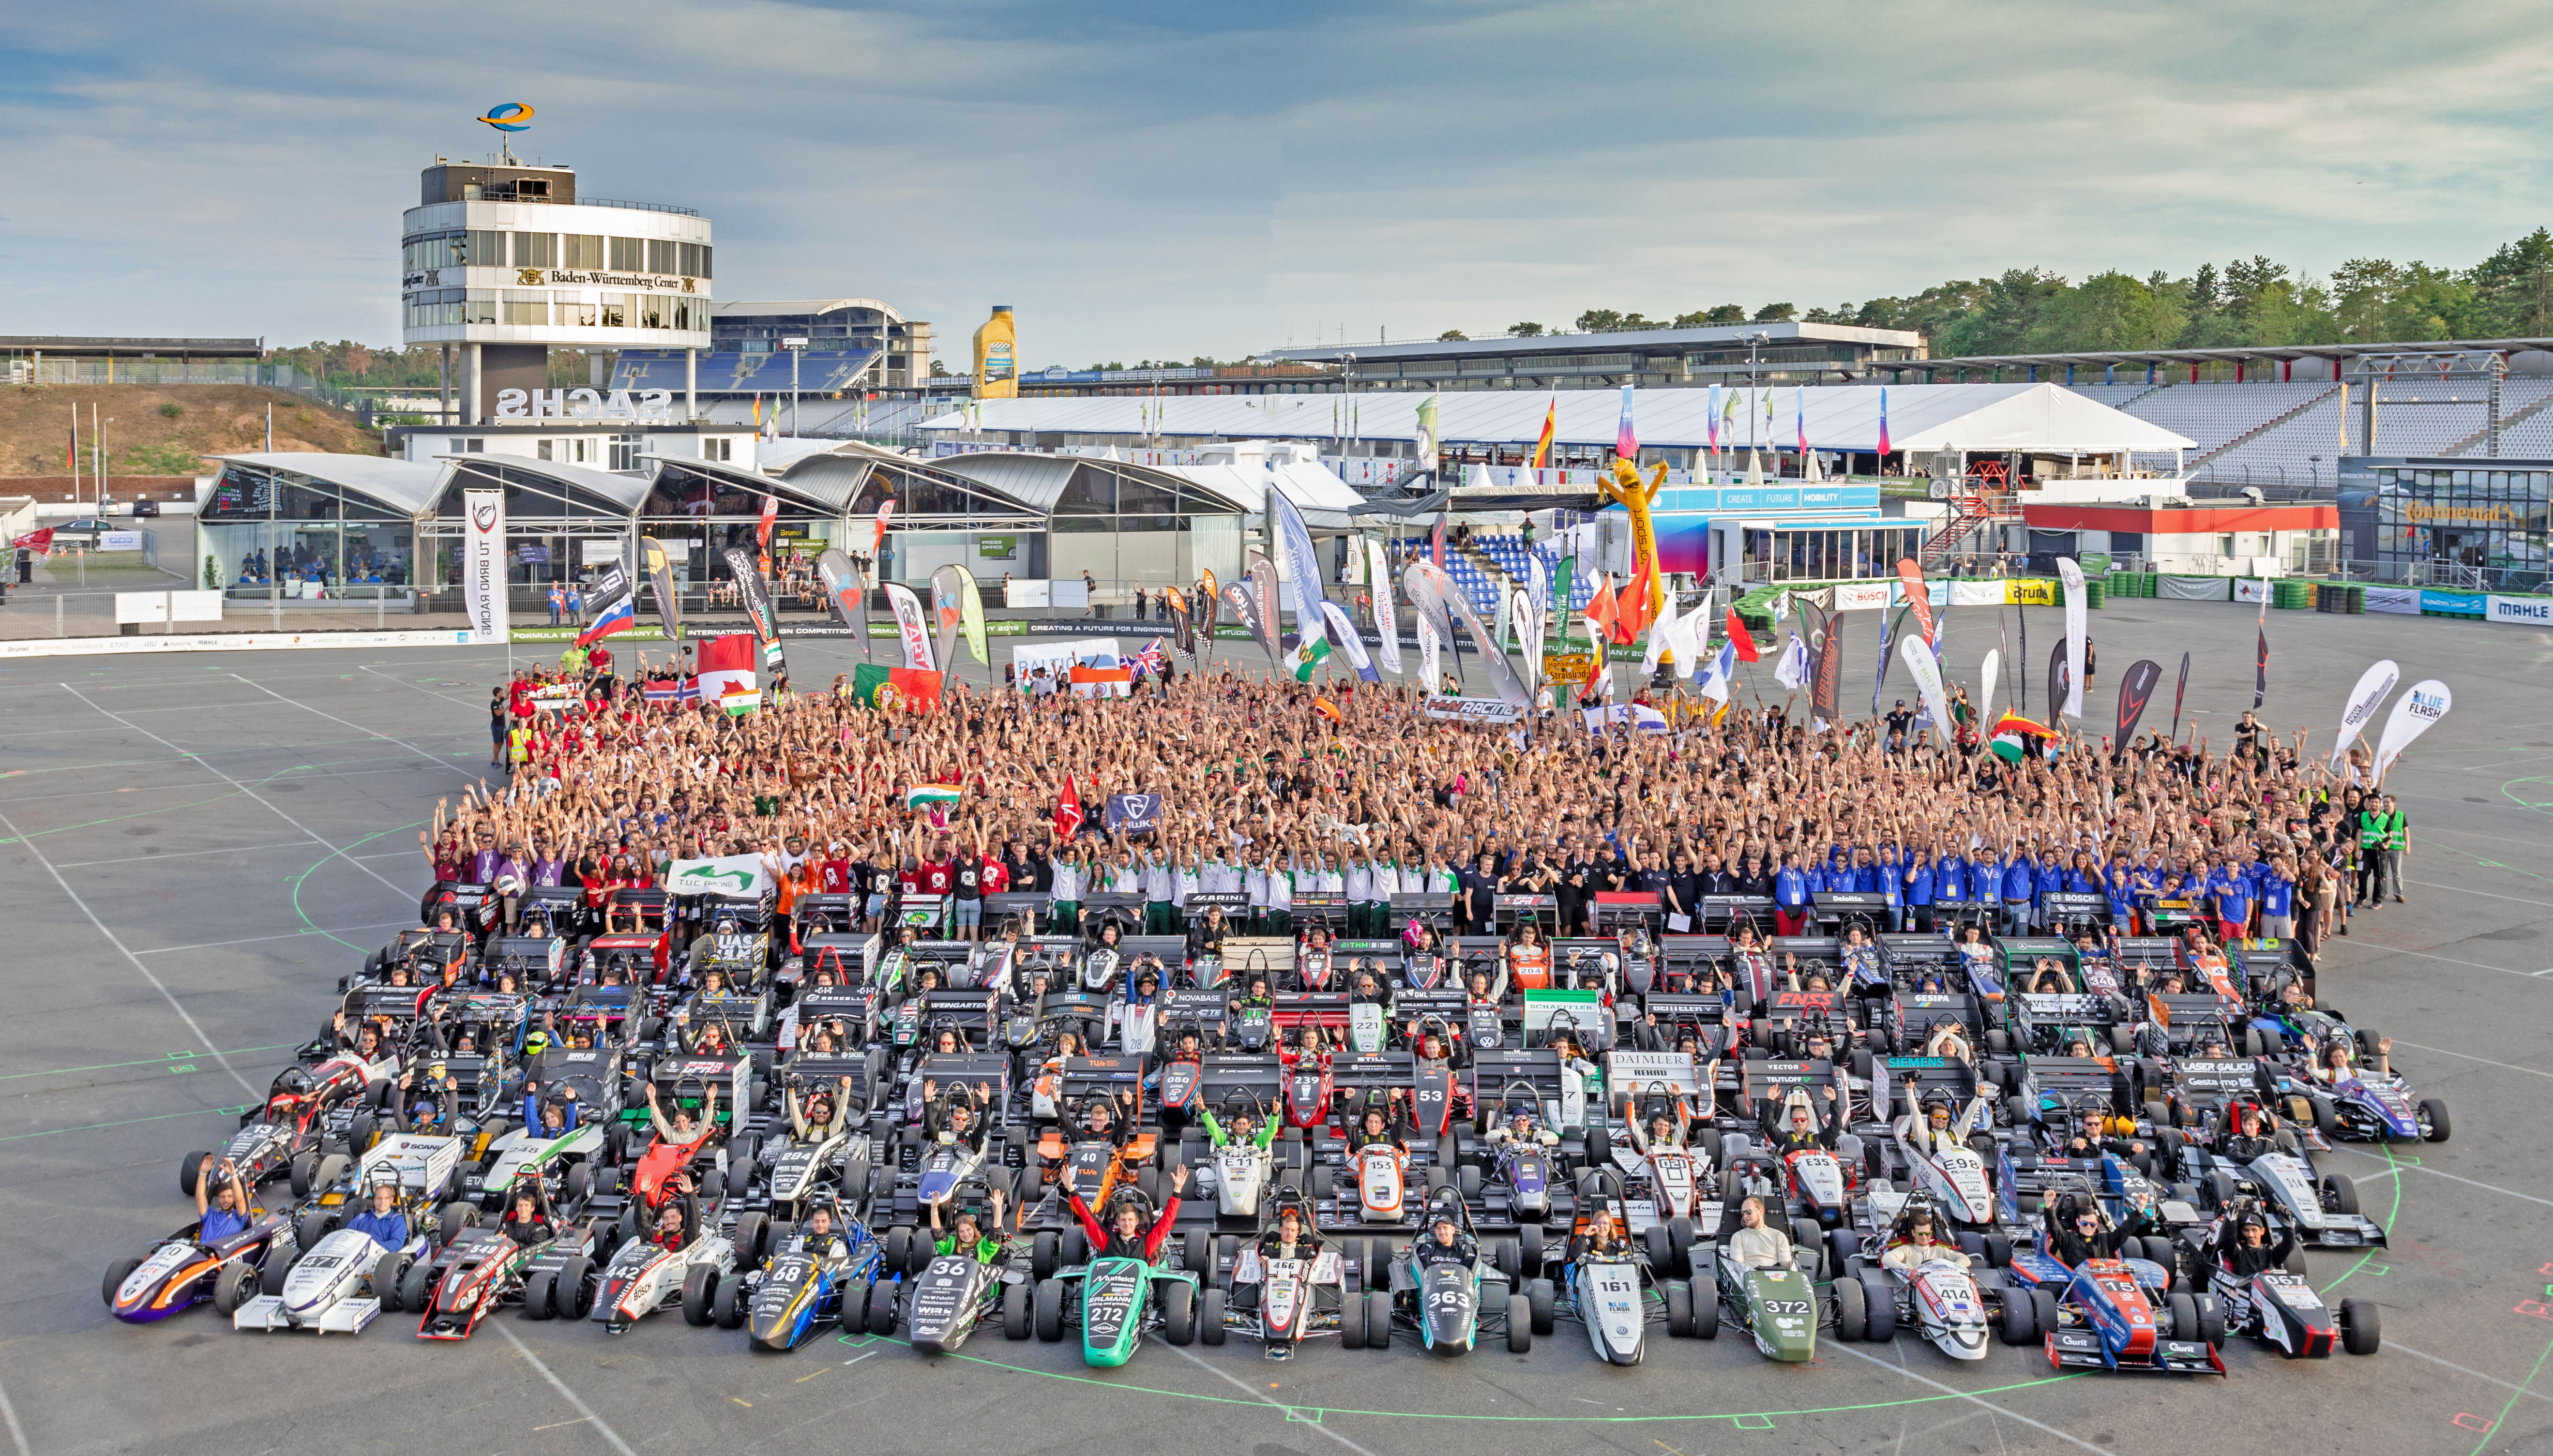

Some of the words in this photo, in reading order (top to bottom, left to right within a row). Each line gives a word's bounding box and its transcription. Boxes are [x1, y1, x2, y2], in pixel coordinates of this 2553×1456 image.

[551, 271, 652, 290] Baden-Württemberg
[654, 276, 679, 288] Center
[2405, 500, 2499, 523] Continental
[1858, 591, 1887, 600] BOSCH
[2498, 603, 2548, 617] MAHLE
[1424, 605, 1449, 639] RACING
[1019, 657, 1075, 675] BALTIC
[1550, 671, 1586, 679] Stralsund
[2413, 690, 2444, 709] BLUE
[2346, 705, 2363, 724] HAWK
[2409, 703, 2441, 718] FLASH
[718, 935, 752, 949] UAS
[2243, 938, 2279, 950] NXP
[2091, 976, 2115, 987] 340
[1778, 993, 1834, 1005] FNSS
[516, 1004, 525, 1021] 215
[1615, 1054, 1685, 1064] DAIMLER
[1889, 1057, 1944, 1066] SIEMENS
[2182, 1063, 2216, 1071] LASER
[2219, 1062, 2256, 1072] GALICIA
[1420, 1091, 1442, 1101] 53
[254, 1125, 272, 1134] 13
[506, 1145, 538, 1154] 248
[781, 1152, 811, 1160] 294
[1081, 1153, 1096, 1162] 40
[1225, 1158, 1251, 1166] E11
[1371, 1161, 1391, 1169] 153
[1943, 1158, 1979, 1170] E98
[2124, 1177, 2146, 1187] 23
[1941, 1181, 1964, 1212] SIEMENS
[302, 1258, 340, 1267] 471
[475, 1265, 488, 1278] UNI
[487, 1246, 509, 1269] ERLANGEN
[932, 1261, 965, 1275] 36
[606, 1266, 639, 1278] 442
[773, 1267, 800, 1281] 68
[2222, 1273, 2237, 1285] DELHI
[2265, 1276, 2303, 1285] 067
[634, 1282, 651, 1301] BOSCH
[963, 1279, 975, 1302] CHEMNITZ
[1600, 1281, 1631, 1291] 161
[2106, 1281, 2135, 1291] 15
[594, 1279, 606, 1308] DAIMLER
[612, 1282, 635, 1310] DAIMLER
[798, 1283, 819, 1309] MANNHEIM
[1429, 1291, 1470, 1307] 363
[1941, 1289, 1971, 1300] 414
[1767, 1302, 1810, 1313] 372
[957, 1307, 977, 1328] SIEMENS
[1091, 1307, 1122, 1321] 272
[2063, 1335, 2087, 1346] Gurit
[2168, 1342, 2194, 1353] Gurit
